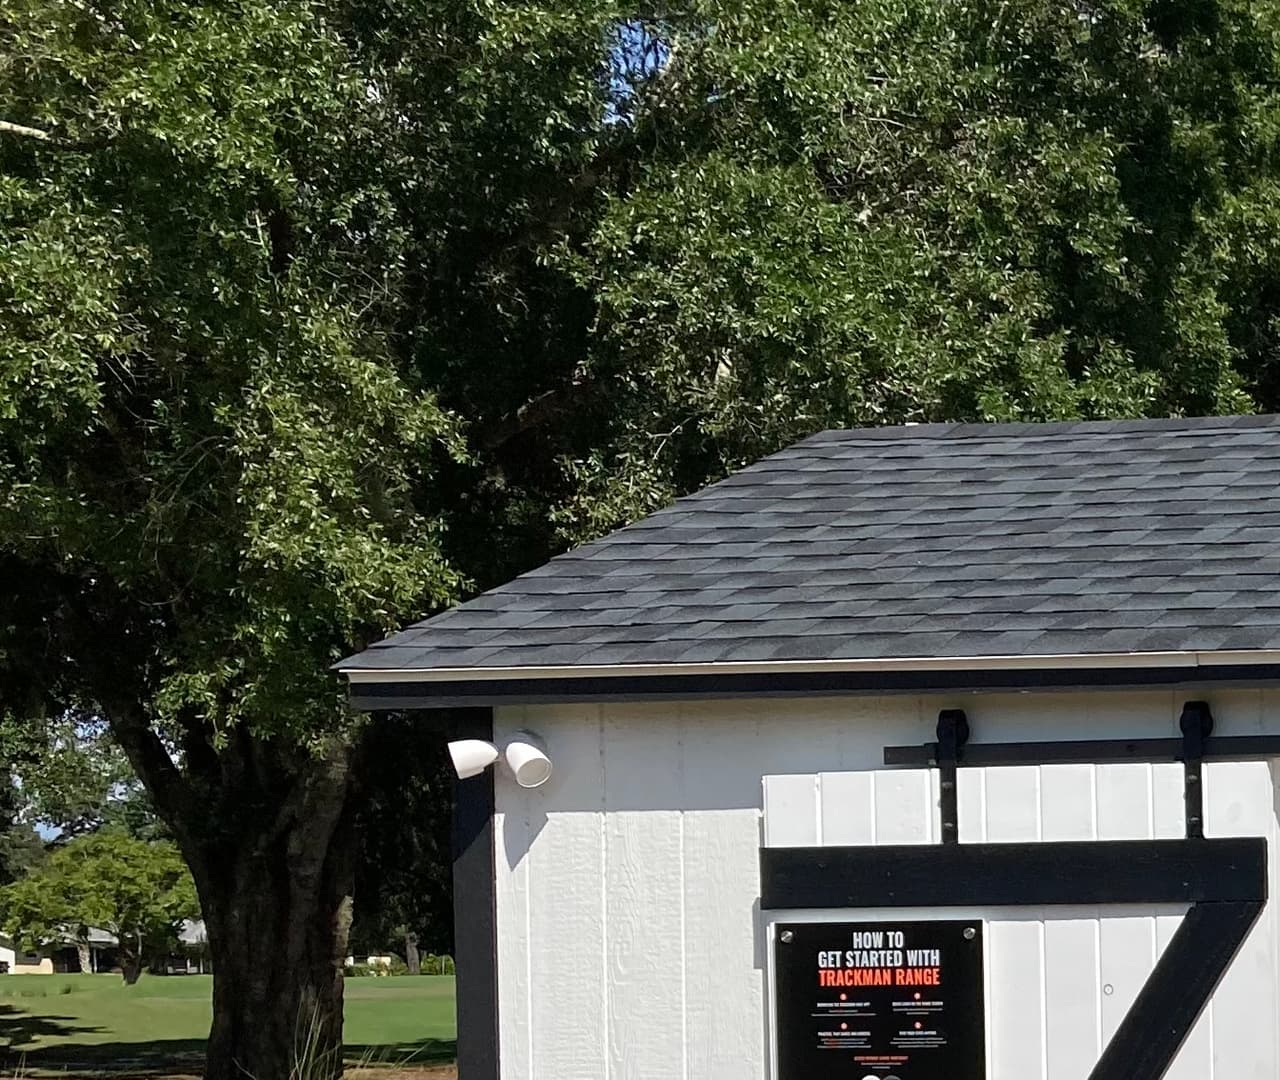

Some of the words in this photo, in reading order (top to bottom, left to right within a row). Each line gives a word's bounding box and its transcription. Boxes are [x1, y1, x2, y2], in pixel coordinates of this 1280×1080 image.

[852, 931, 883, 949] HOW
[887, 931, 904, 949] TO
[818, 951, 842, 968] GET
[845, 950, 902, 968] STARTED
[906, 949, 940, 967] WITH
[818, 969, 891, 986] TRACKMAN
[895, 968, 940, 985] RANGE
